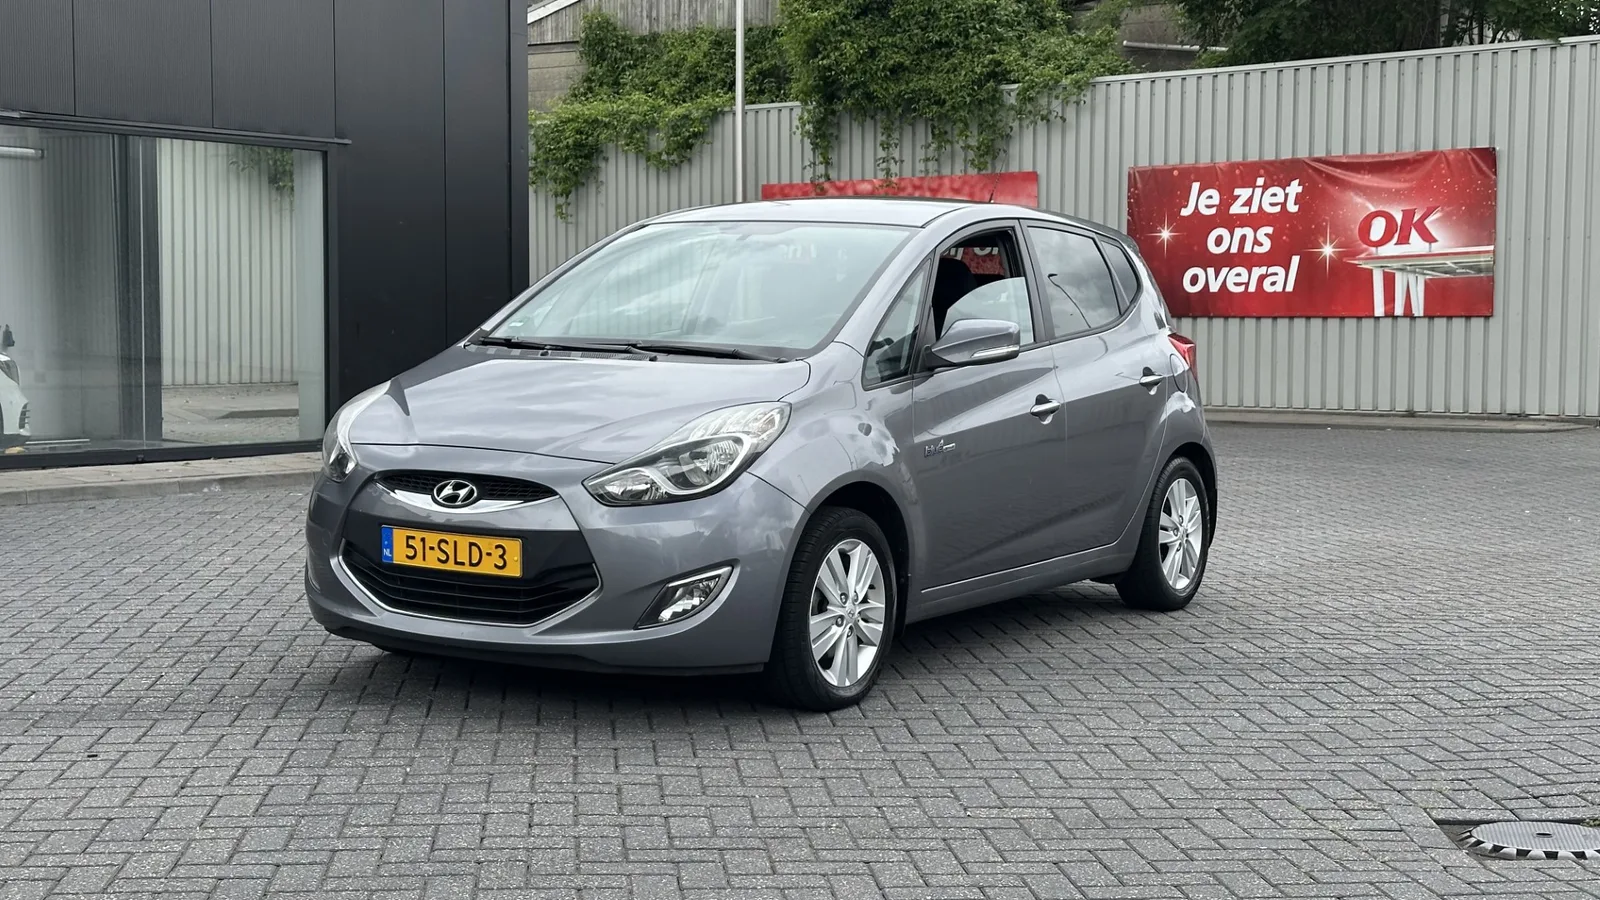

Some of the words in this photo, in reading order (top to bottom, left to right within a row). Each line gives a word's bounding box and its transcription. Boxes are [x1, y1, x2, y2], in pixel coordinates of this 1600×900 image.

[1180, 182, 1220, 216] Je
[1229, 177, 1302, 215] ziet
[1206, 225, 1273, 254] ons
[1357, 205, 1442, 248] OK
[1182, 255, 1300, 293] overal
[383, 548, 392, 557] NL
[405, 534, 507, 570] 51-SLD-3
